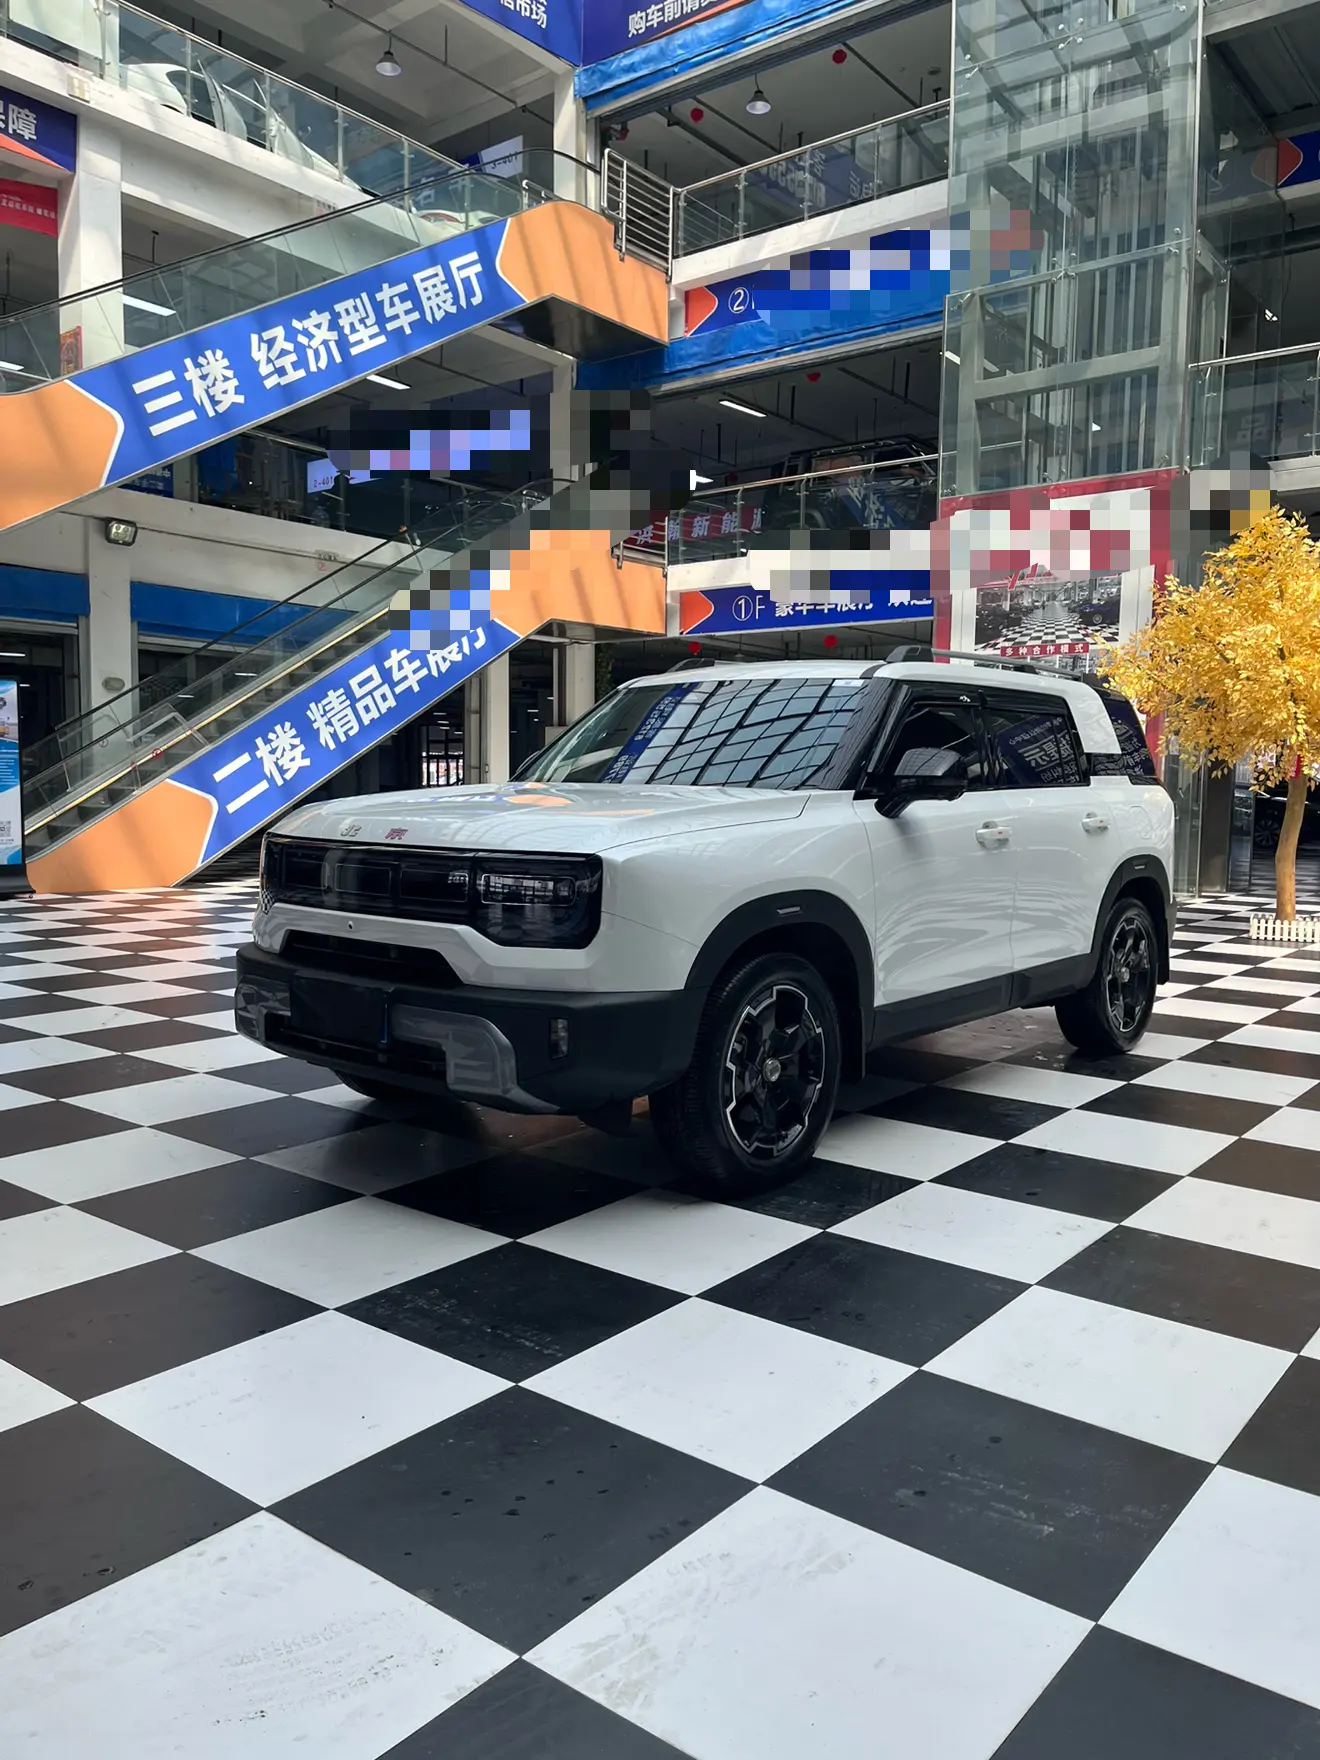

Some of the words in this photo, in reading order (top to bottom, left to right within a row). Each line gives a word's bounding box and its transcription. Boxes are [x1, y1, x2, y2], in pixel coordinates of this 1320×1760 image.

[628, 0, 718, 38] 购车前请
[0, 101, 37, 140] 障
[131, 348, 245, 439] 三楼
[249, 250, 485, 390] 经济型车展厅
[1004, 642, 1085, 657] 多种合作模式
[212, 727, 312, 815] 二楼
